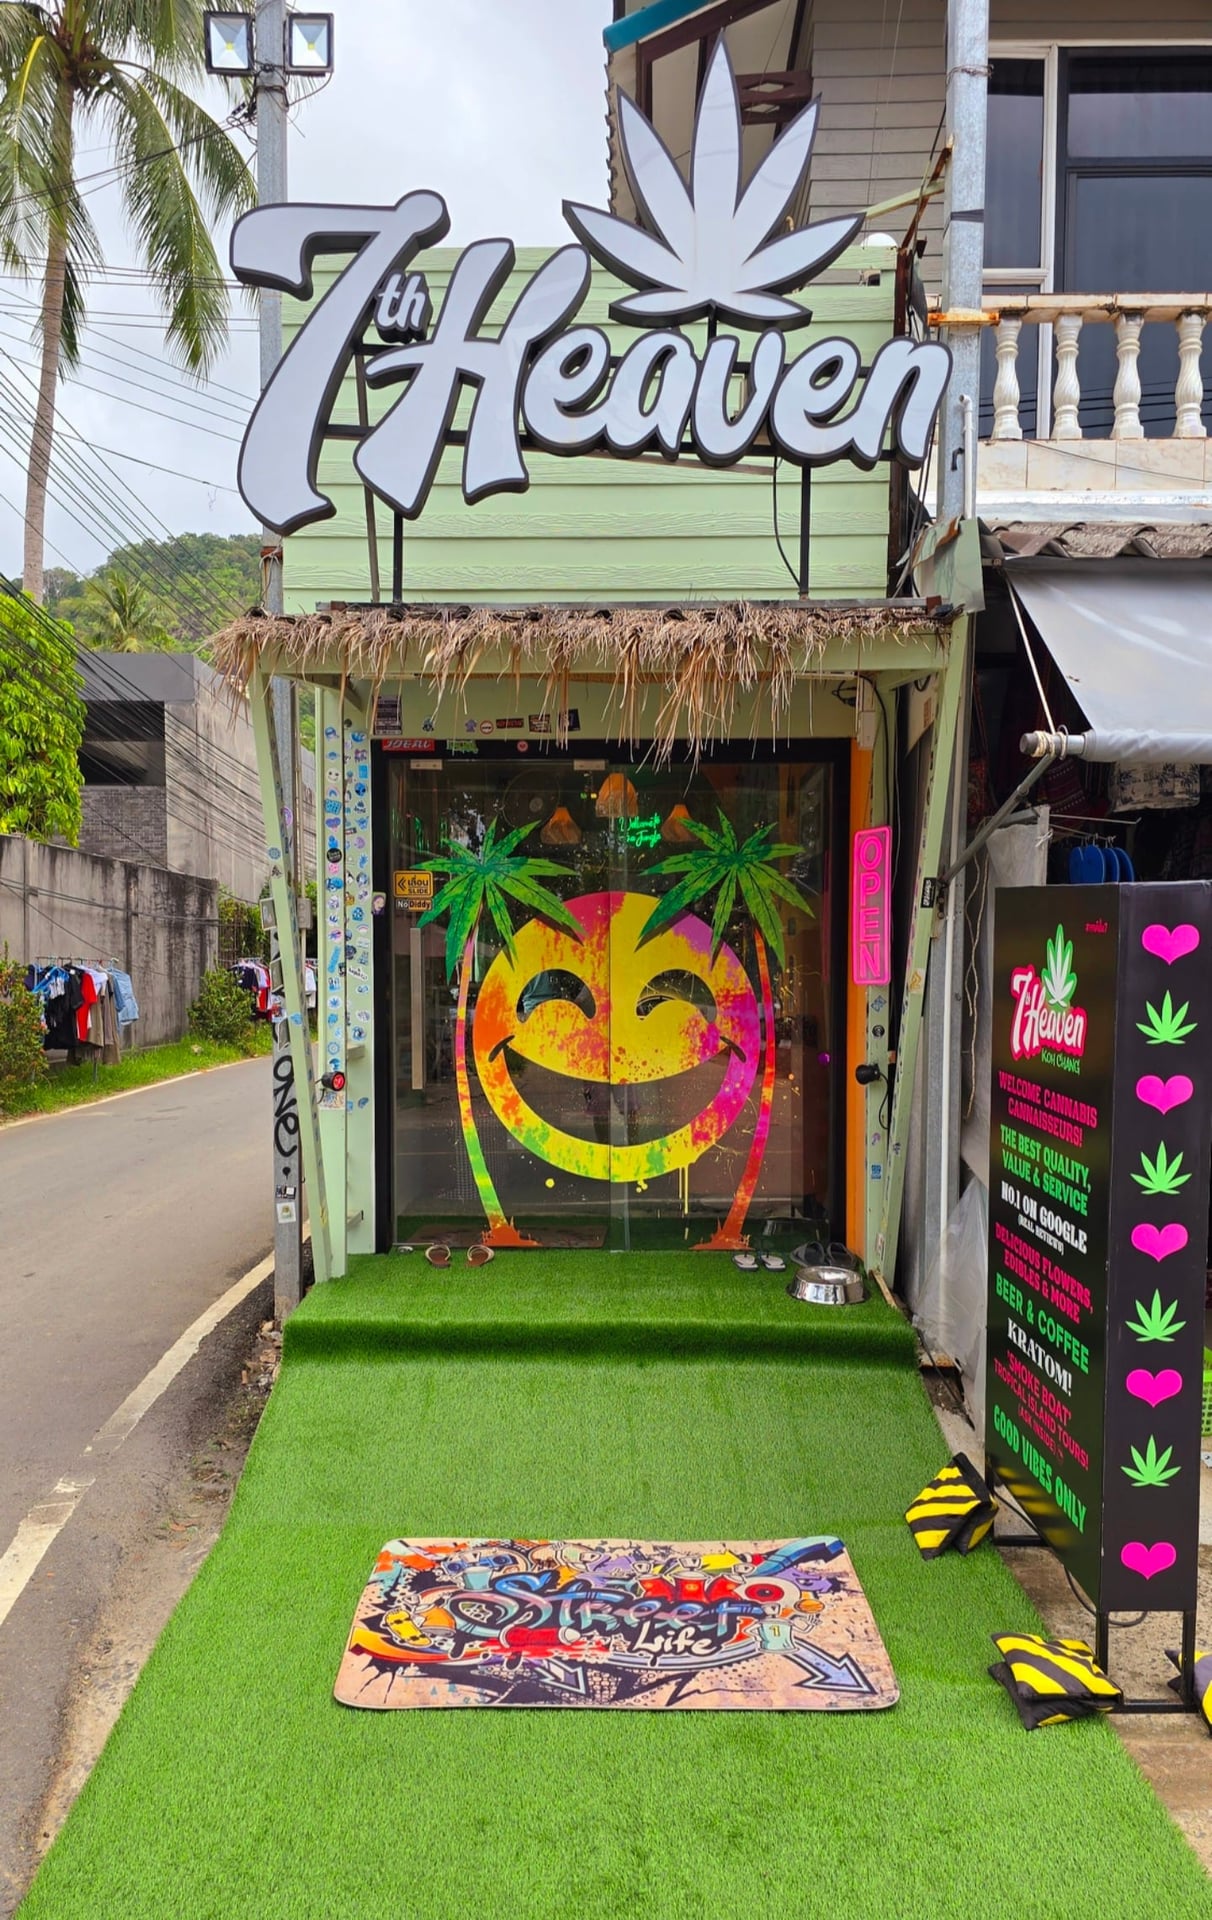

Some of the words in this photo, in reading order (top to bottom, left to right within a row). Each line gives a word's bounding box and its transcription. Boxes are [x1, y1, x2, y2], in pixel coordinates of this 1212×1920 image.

[230, 189, 450, 536] 7th
[354, 238, 953, 520] Heaven
[410, 900, 431, 909] Diddy
[859, 836, 882, 977] OPEN
[1023, 983, 1085, 1052] Heaven
[1041, 1050, 1056, 1067] KOH
[1056, 1056, 1081, 1076] CHANG
[999, 1070, 1042, 1105] WELCOME
[1043, 1088, 1098, 1129] CANNABIS
[1008, 1097, 1083, 1148] CANNAISSEURS!
[1000, 1124, 1017, 1149] THE
[1018, 1133, 1042, 1162] BEST
[1043, 1146, 1092, 1193] QUALITY,
[1002, 1149, 1032, 1183] VALUE
[1032, 1167, 1041, 1188] &
[1042, 1172, 1088, 1216] SERVICE
[995, 1221, 1041, 1270] DELICIOUS
[1001, 1180, 1021, 1210] NO.1
[1022, 1195, 1038, 1221] ON
[1039, 1206, 1088, 1255] GOOGLE
[1004, 1249, 1041, 1292] EDIBLES
[1050, 1284, 1081, 1325] MORE
[996, 1272, 1023, 1316] BEER
[1026, 1299, 1034, 1325] &
[1037, 1310, 1089, 1375] COFFEE
[1007, 1317, 1073, 1397] KRATOM!
[994, 1357, 1027, 1404] TROPICAL
[1027, 1393, 1057, 1434] ISLAND
[1057, 1423, 1089, 1472] TOURS!
[994, 1404, 1020, 1453] GOOD
[1021, 1434, 1053, 1494] VIBES
[1055, 1475, 1087, 1534] ONLY
[632, 1616, 718, 1655] Life
